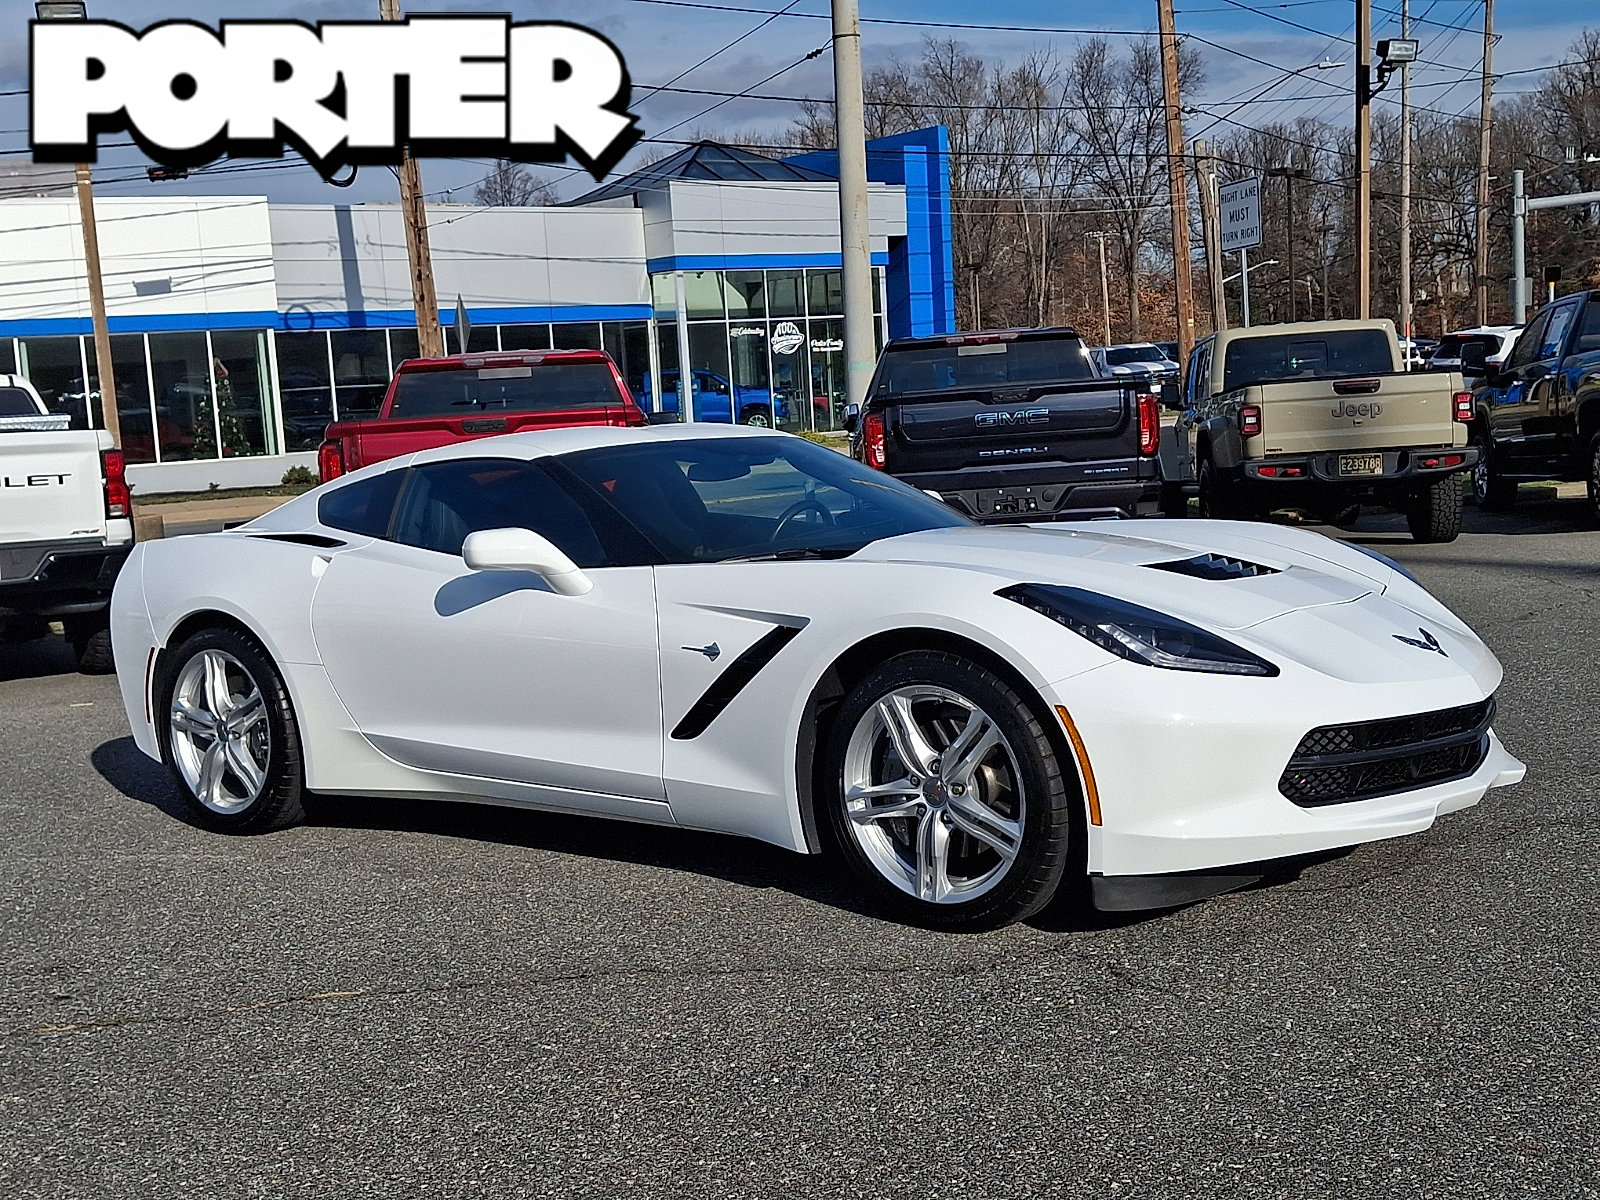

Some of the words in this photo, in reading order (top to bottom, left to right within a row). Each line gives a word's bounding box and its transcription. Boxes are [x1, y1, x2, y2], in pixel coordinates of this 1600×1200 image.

[1221, 191, 1238, 204] RIGHT
[1240, 186, 1256, 200] LANE
[1229, 207, 1250, 223] MUST
[1222, 230, 1239, 243] TURN
[1241, 226, 1258, 239] RIGHT
[974, 408, 1050, 428] GMC
[1331, 401, 1383, 419] Jeep
[978, 446, 1049, 457] DENALI
[0, 473, 72, 488] LET
